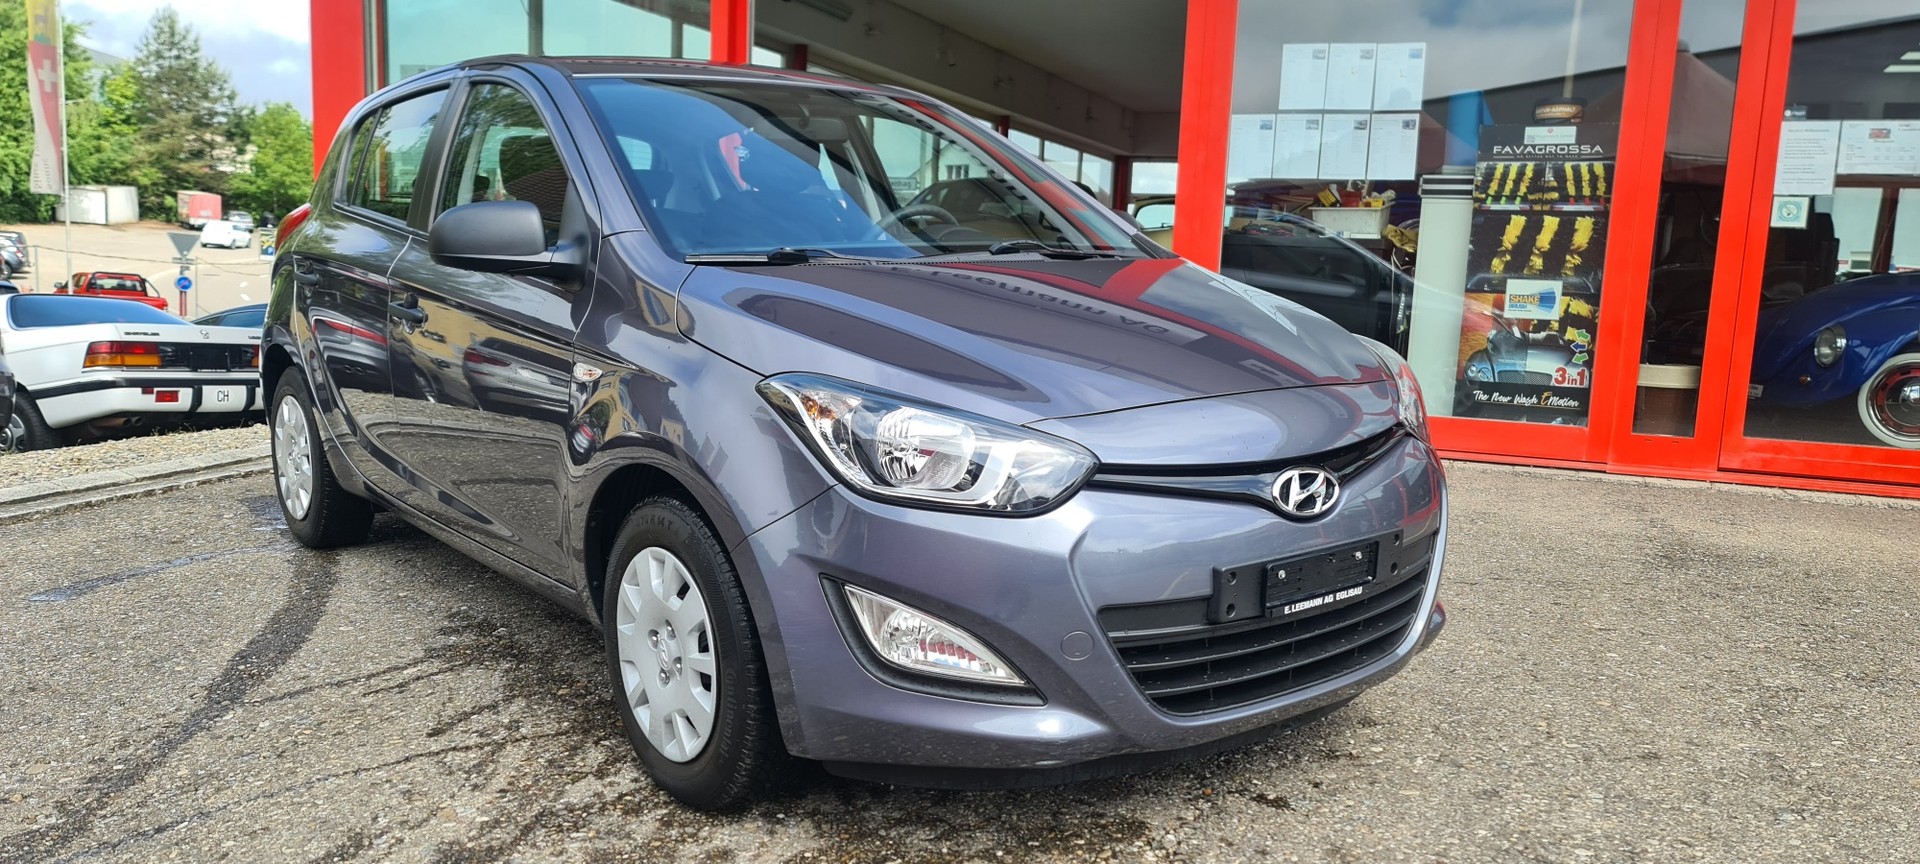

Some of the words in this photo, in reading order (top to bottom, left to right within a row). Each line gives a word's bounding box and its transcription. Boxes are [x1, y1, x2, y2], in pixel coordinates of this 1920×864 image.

[1493, 144, 1604, 154] FAVAGROSSA
[1509, 294, 1540, 304] SHAKE
[216, 389, 230, 403] CH
[1472, 390, 1489, 401] The
[1491, 391, 1512, 403] New
[1514, 393, 1538, 406] Wash
[1291, 597, 1323, 612] LEEMANN
[1324, 594, 1334, 605] AG
[1336, 586, 1363, 600] EGLISAU
